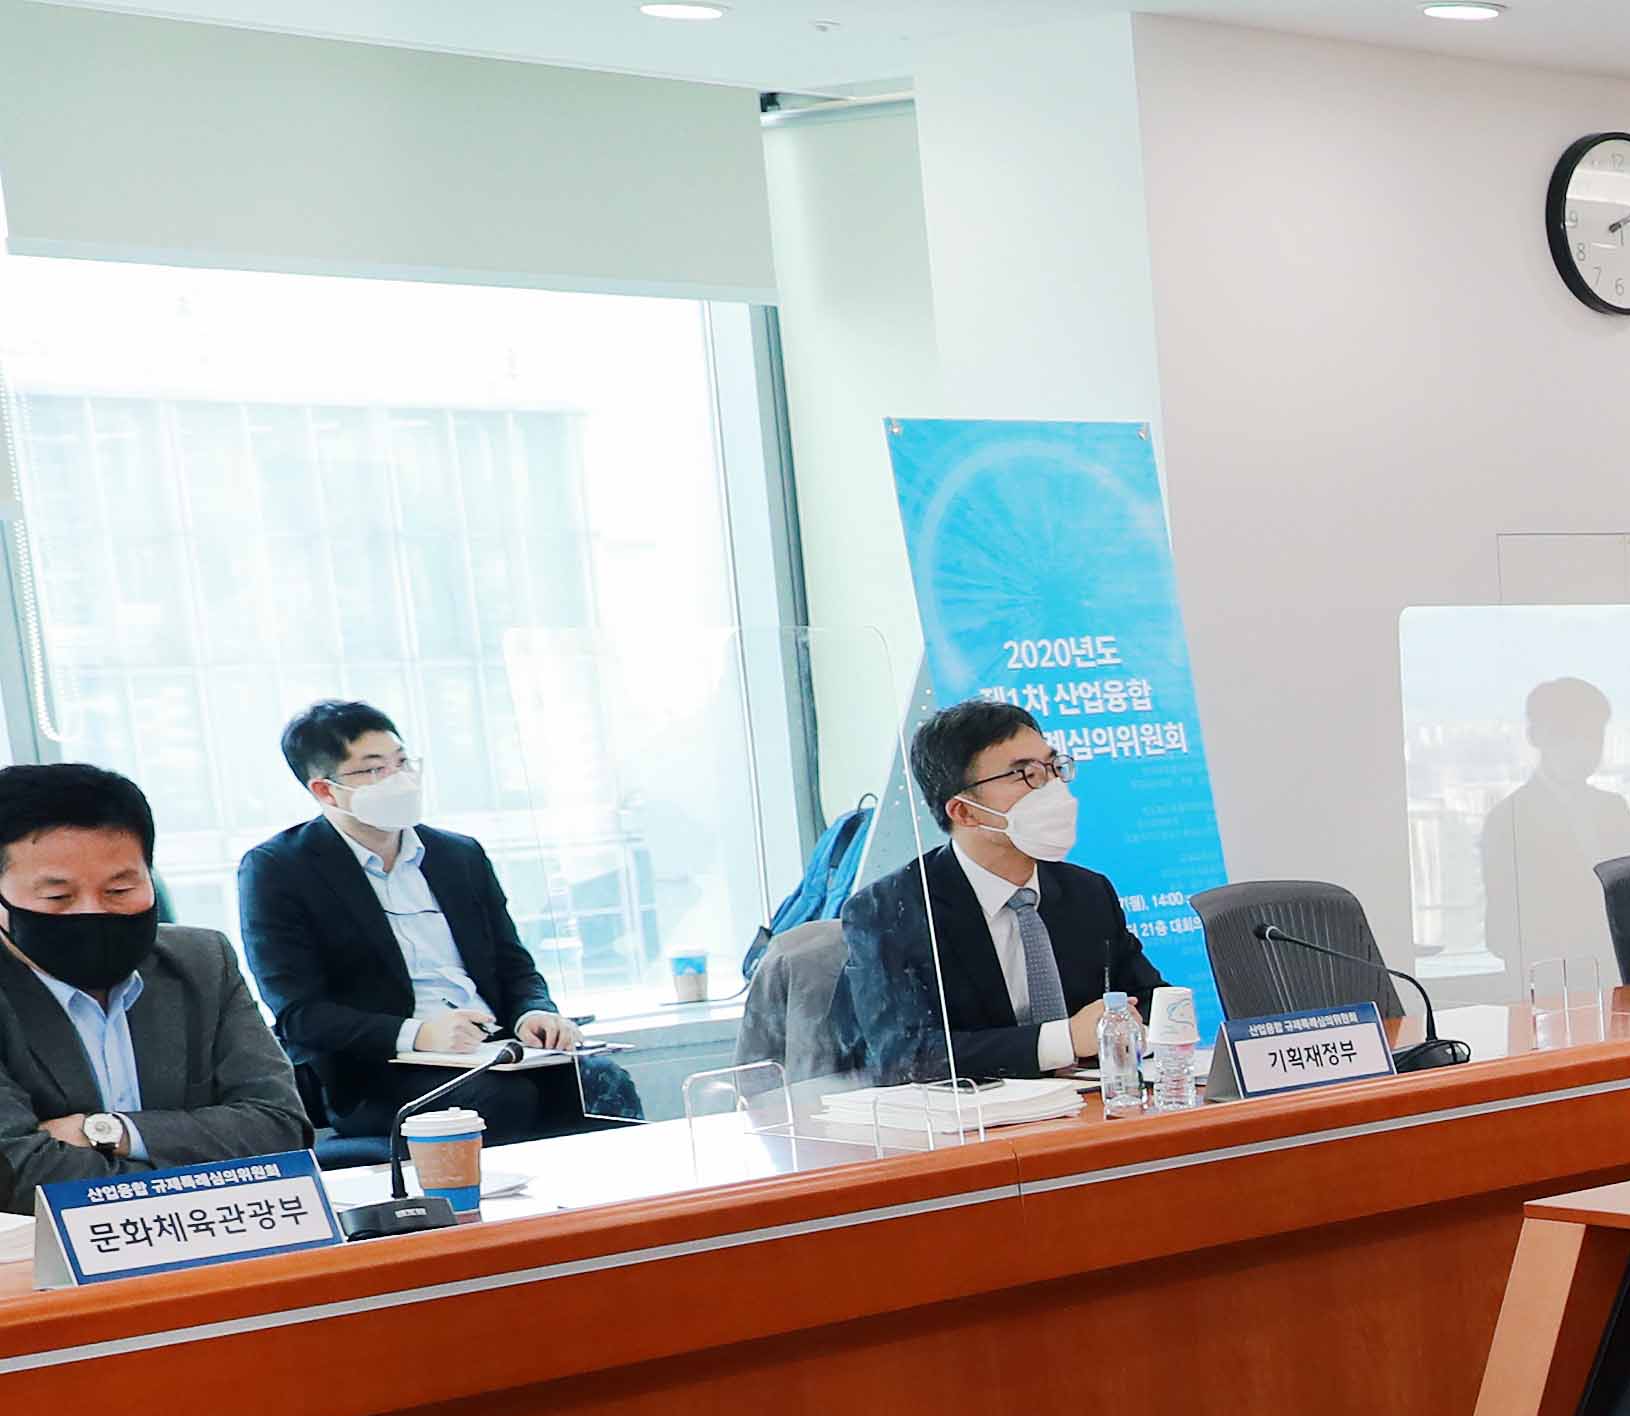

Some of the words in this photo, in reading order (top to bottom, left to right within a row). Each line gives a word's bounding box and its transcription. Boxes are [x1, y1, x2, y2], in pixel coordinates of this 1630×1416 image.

[1576, 243, 1586, 262] 8
[1615, 278, 1625, 296] 6
[1003, 635, 1123, 670] 2020년도
[1054, 678, 1153, 716] 산업융합
[1044, 721, 1188, 761] 례심의위원회
[1268, 1040, 1357, 1072] 기획재정부
[88, 1182, 148, 1202] 산업융합
[90, 1196, 308, 1253] 문화체육관광부
